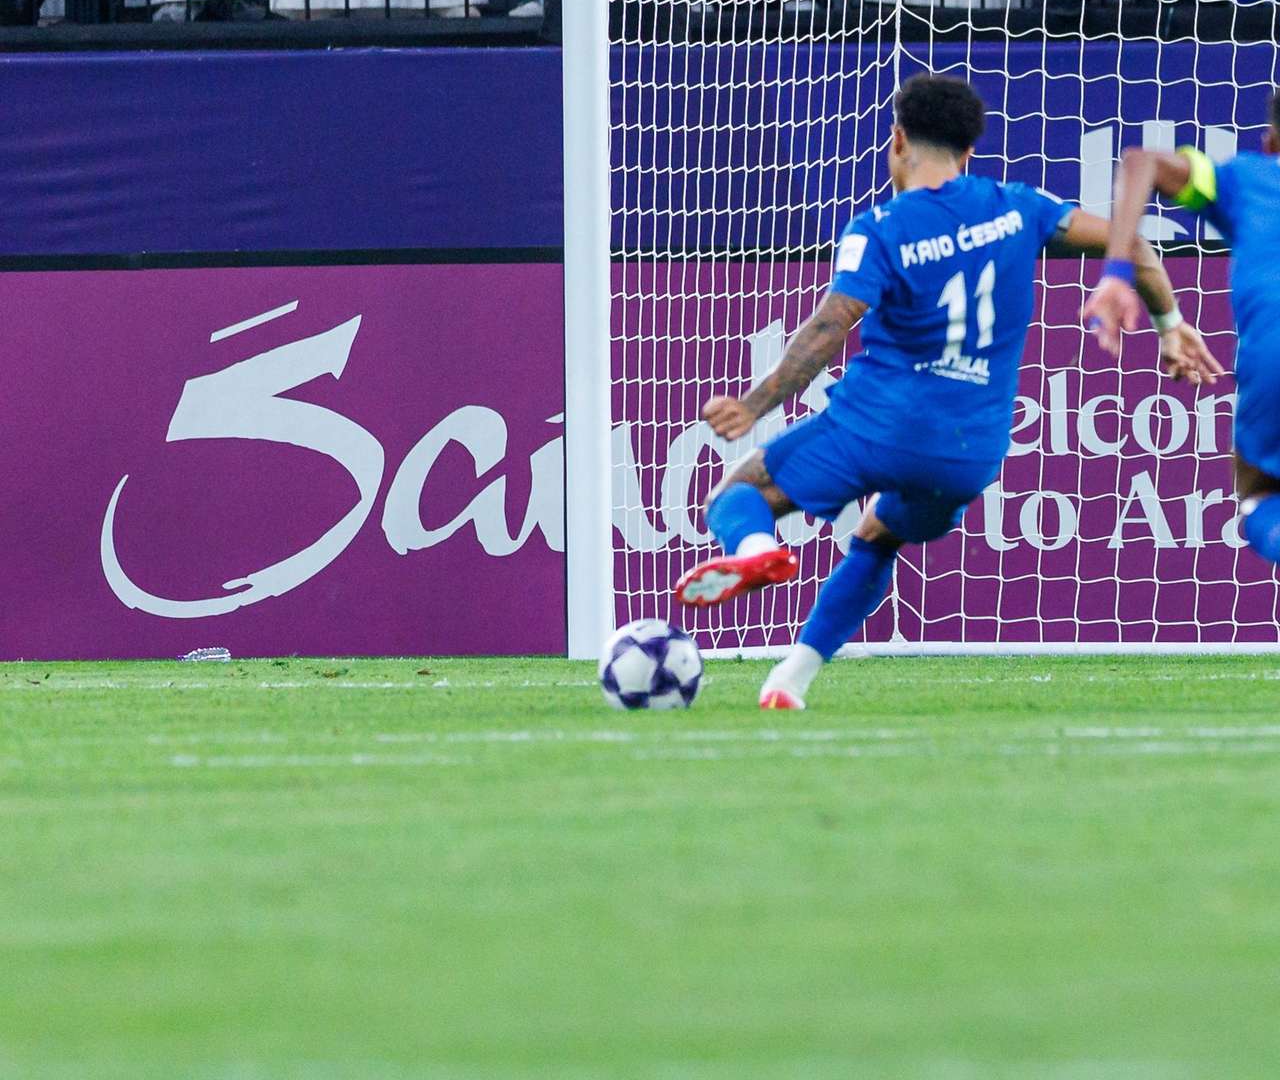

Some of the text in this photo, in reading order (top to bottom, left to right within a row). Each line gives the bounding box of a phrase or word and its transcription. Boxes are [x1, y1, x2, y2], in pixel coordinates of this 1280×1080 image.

[900, 234, 955, 269] KAIO
[938, 260, 996, 362] 11
[100, 299, 864, 618] Saud
[982, 480, 1077, 552] to
